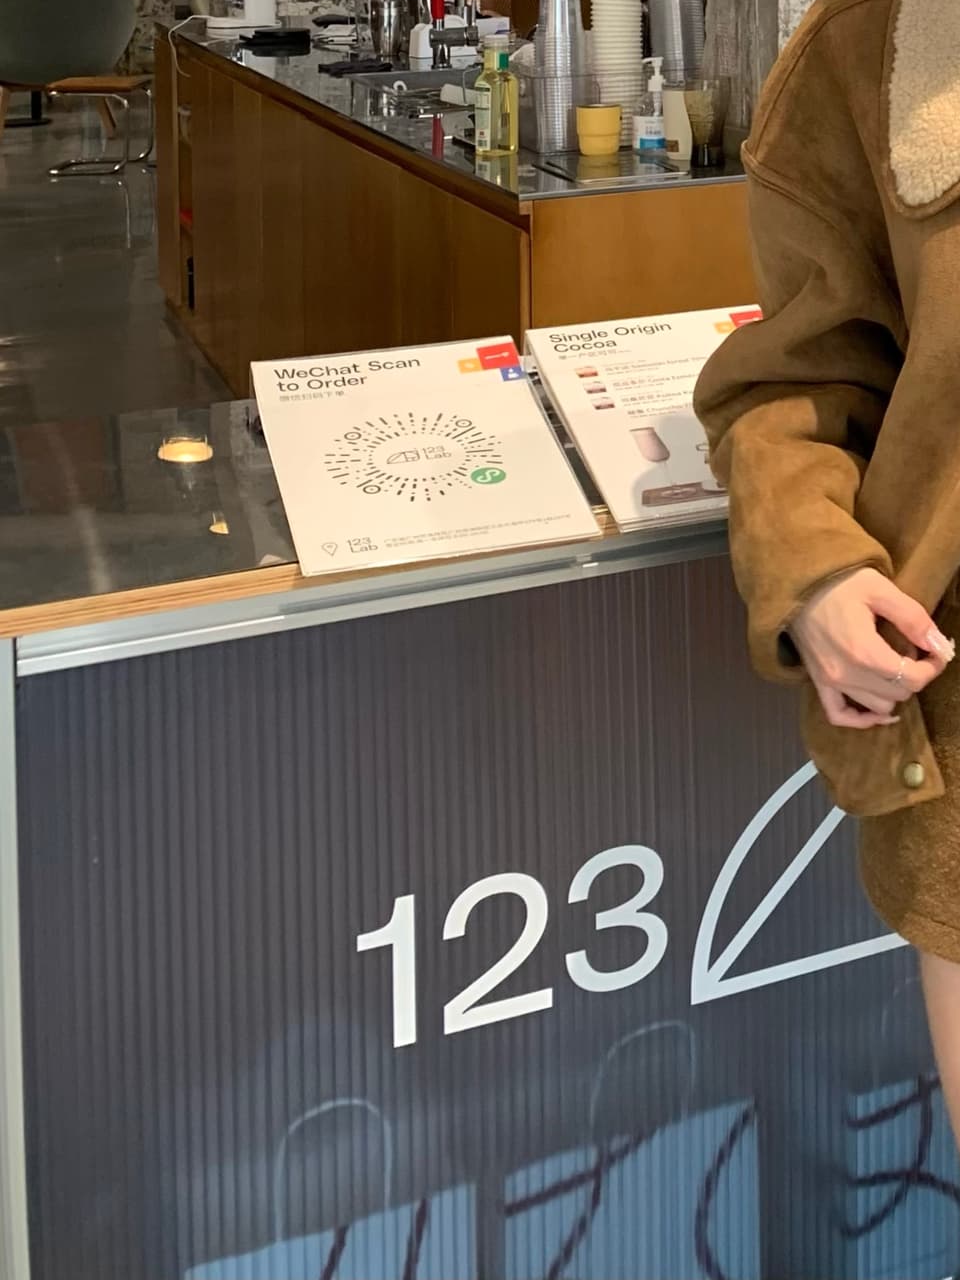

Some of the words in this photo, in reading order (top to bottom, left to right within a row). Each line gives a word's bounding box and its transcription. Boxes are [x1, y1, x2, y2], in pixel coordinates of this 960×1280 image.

[549, 329, 609, 343] Single
[614, 322, 672, 336] Origin
[553, 339, 618, 353] Cocoa
[274, 363, 361, 380] WeChat
[368, 358, 421, 372] Scan
[276, 381, 299, 392] to
[307, 376, 368, 390] Order
[347, 537, 372, 547] 123
[350, 543, 379, 554] Lab
[356, 843, 669, 1050] 123
